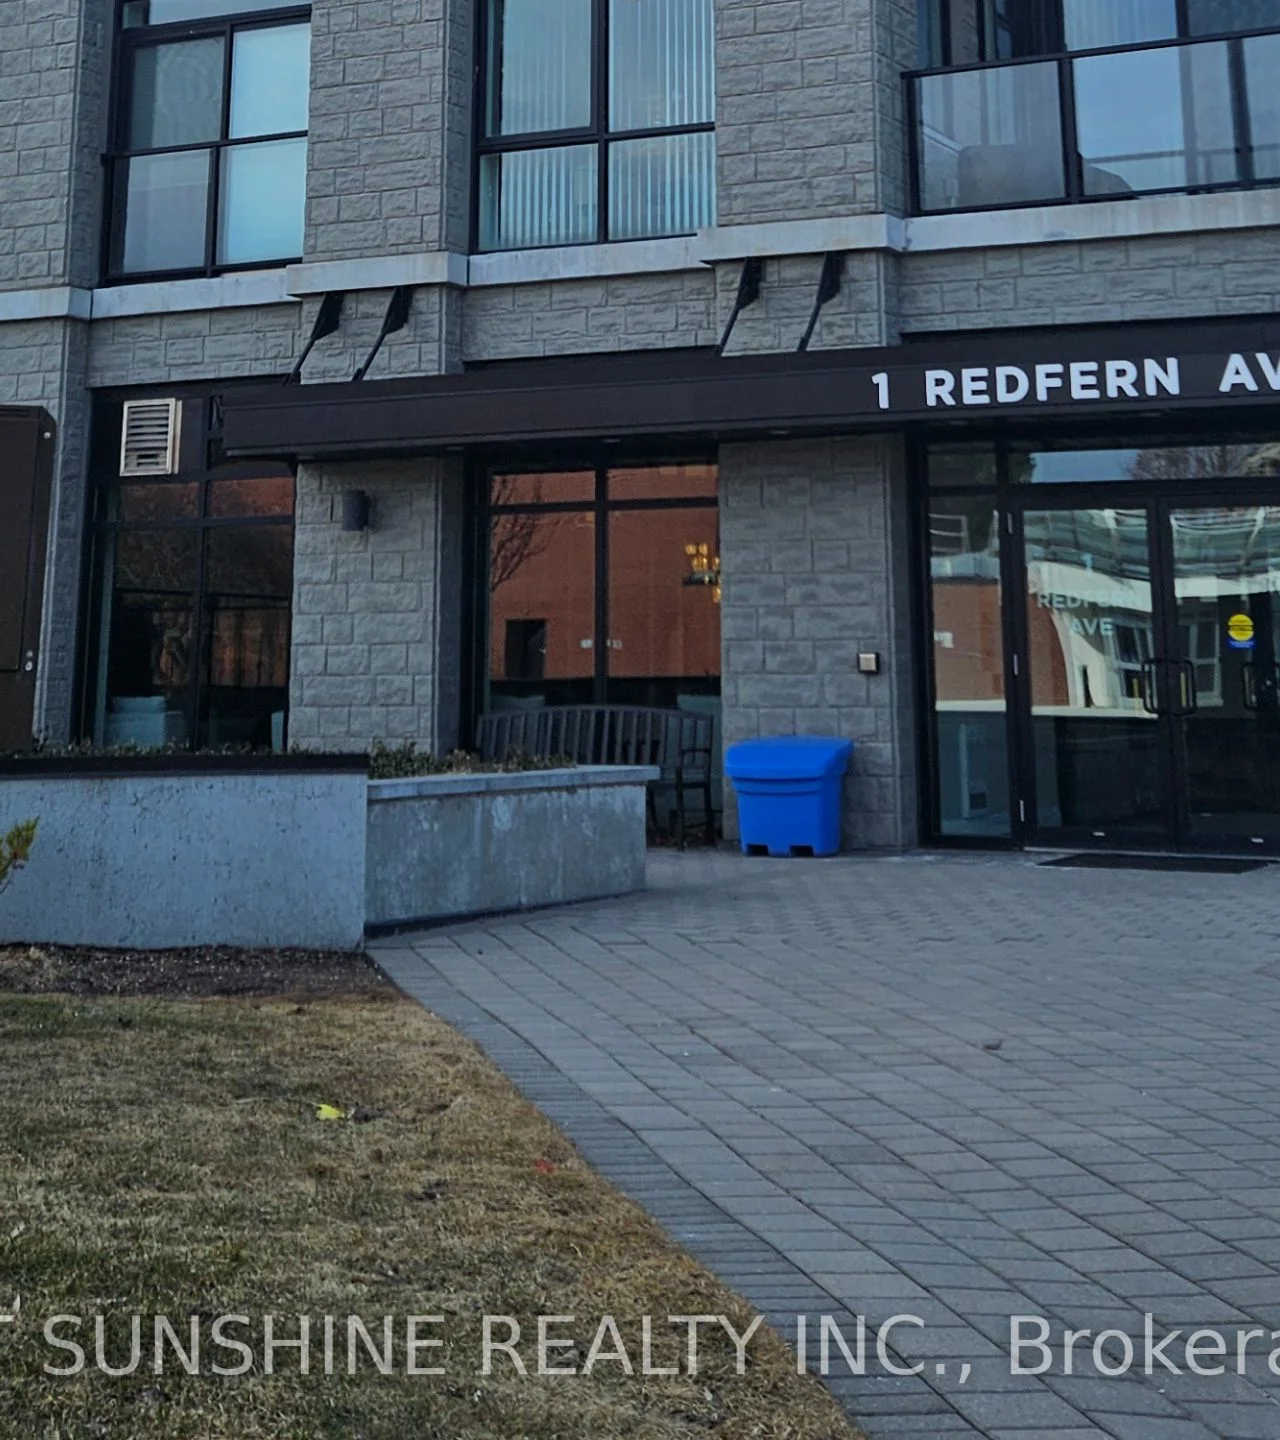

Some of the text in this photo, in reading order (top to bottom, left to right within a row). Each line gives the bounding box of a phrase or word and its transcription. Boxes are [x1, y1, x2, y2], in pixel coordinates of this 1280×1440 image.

[871, 372, 889, 409] 1
[925, 357, 1180, 407] REDFERN
[1071, 617, 1114, 636] AVE
